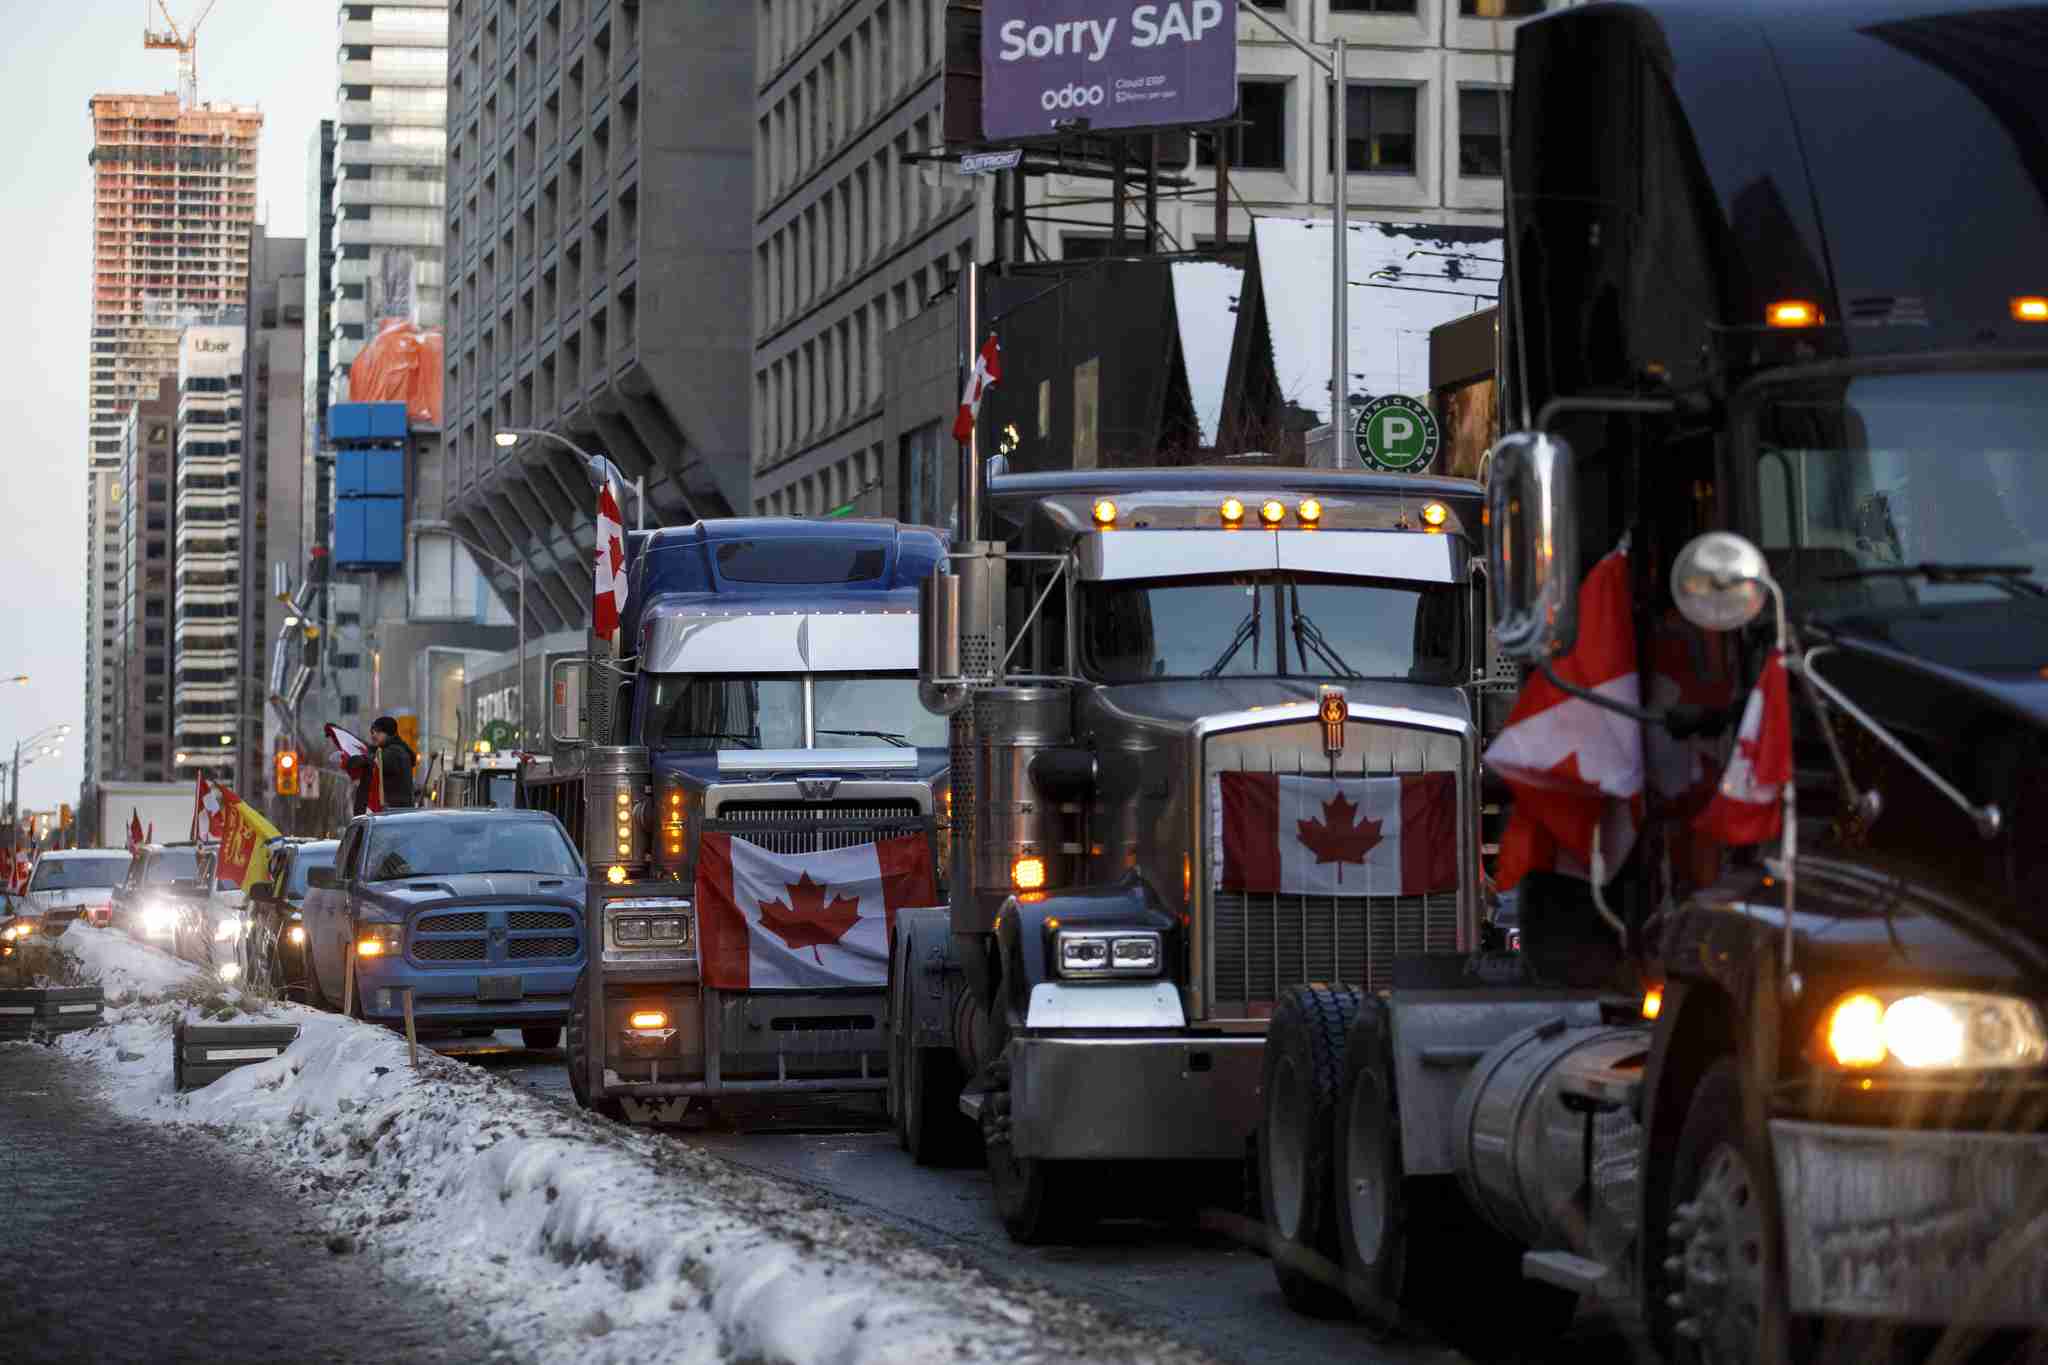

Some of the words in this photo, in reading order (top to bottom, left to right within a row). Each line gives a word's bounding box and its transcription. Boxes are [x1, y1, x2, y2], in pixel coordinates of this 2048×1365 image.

[1000, 17, 1117, 62] Sorry
[1131, 0, 1223, 48] SAP
[1041, 83, 1105, 111] odoo
[194, 338, 231, 353] Uber
[1359, 398, 1435, 433] MUNICIPAL
[1383, 416, 1413, 449] P
